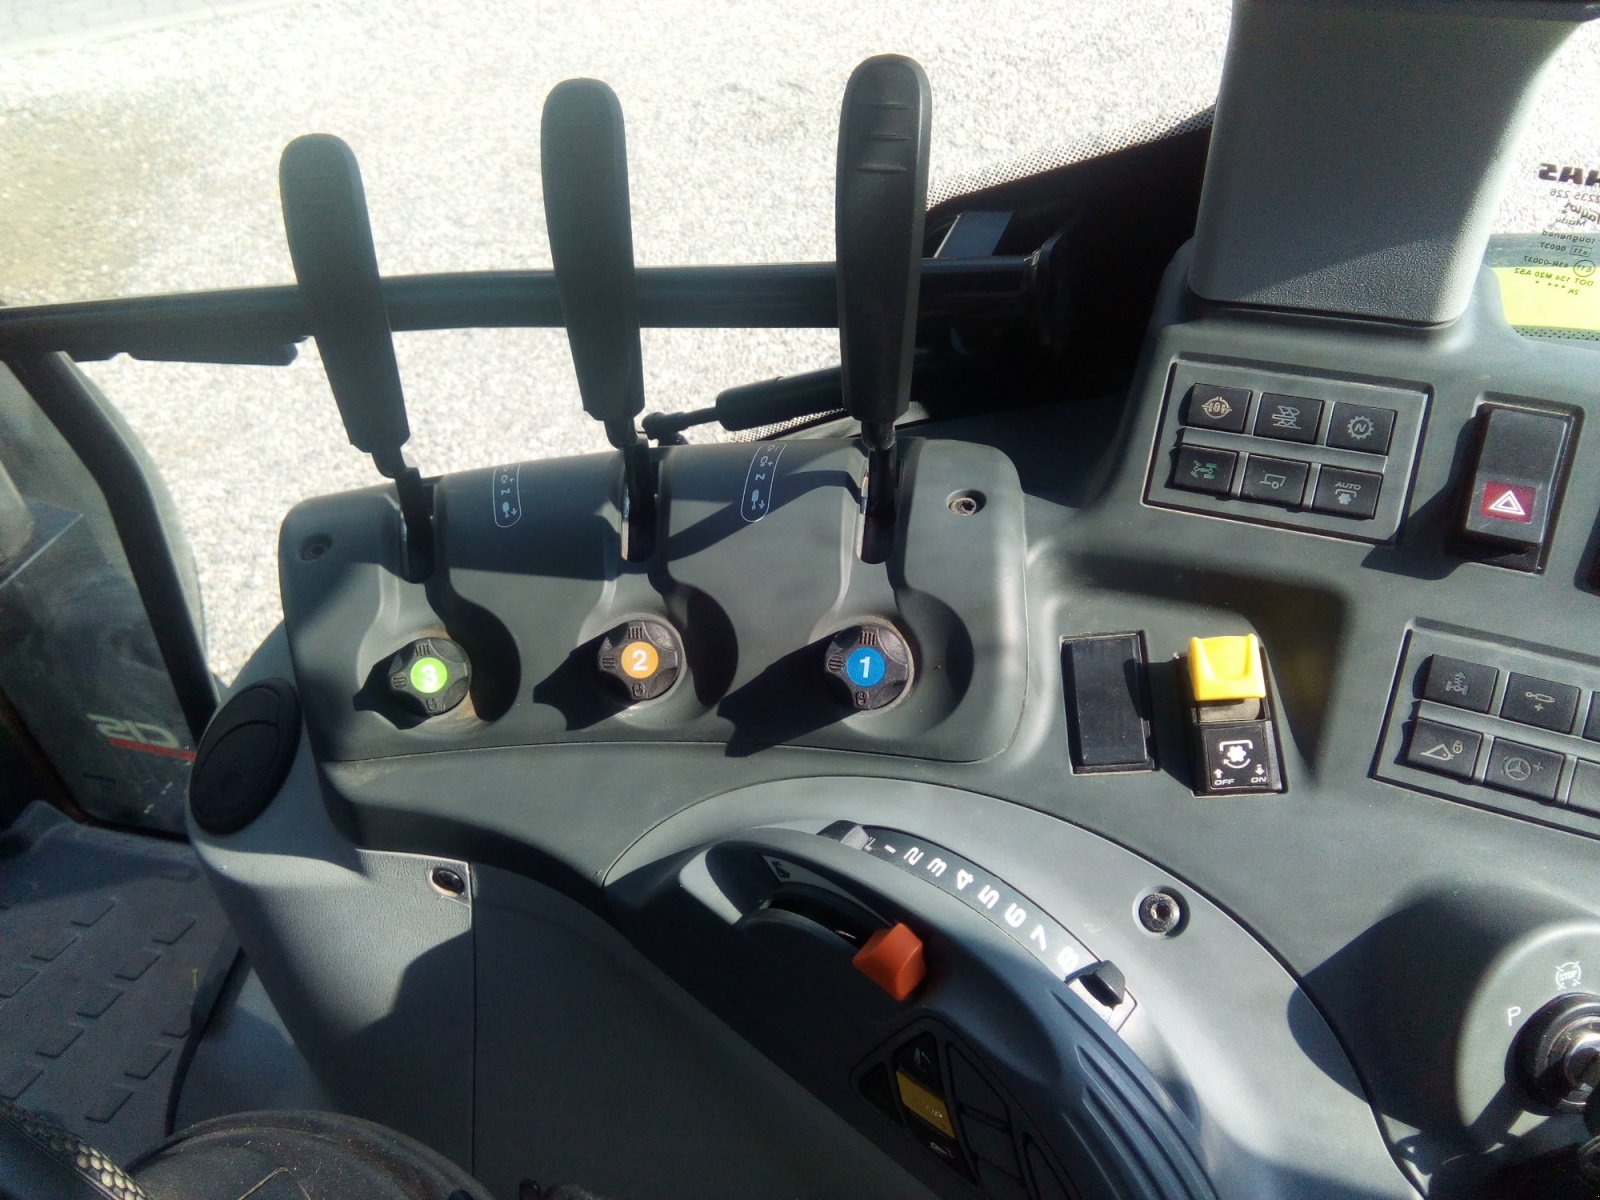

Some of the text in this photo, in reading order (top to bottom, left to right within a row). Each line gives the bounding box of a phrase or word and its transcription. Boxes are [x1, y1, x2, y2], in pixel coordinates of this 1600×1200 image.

[1335, 482, 1361, 491] AUTO
[631, 650, 648, 671] 2
[860, 656, 871, 679] 1
[420, 665, 438, 686] 3
[1214, 778, 1235, 786] OFF
[927, 857, 947, 878] 3
[956, 869, 974, 891] 4
[977, 884, 1000, 909] 5
[1004, 903, 1027, 928] 6
[1030, 924, 1047, 952] 7
[1508, 1006, 1521, 1027] P
